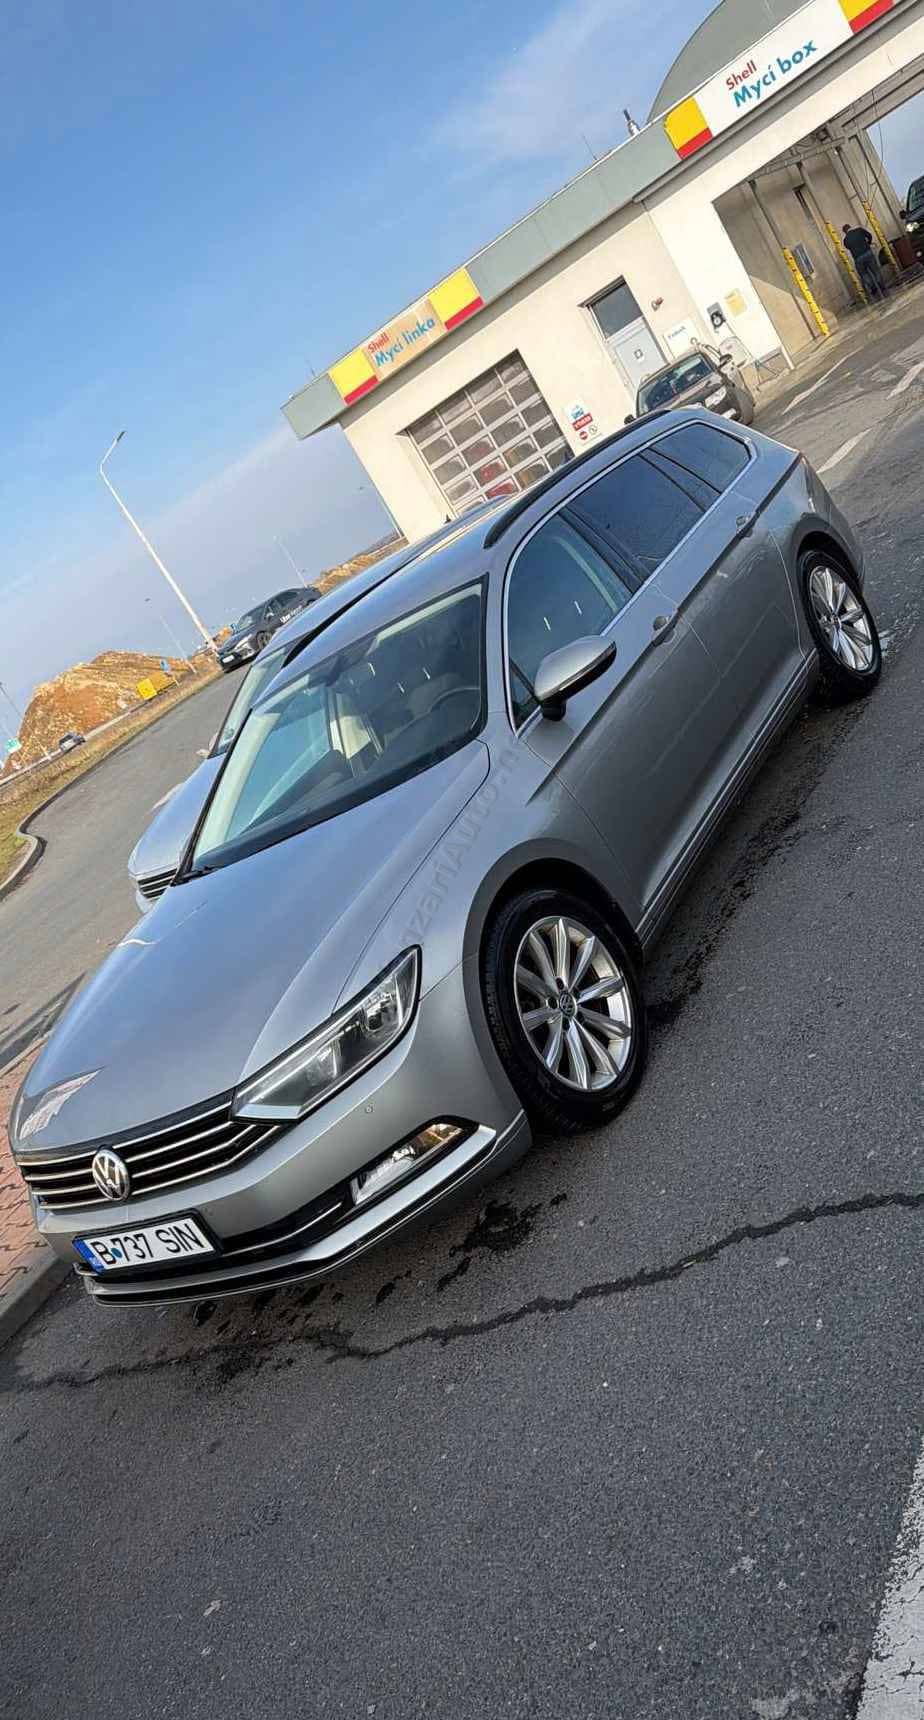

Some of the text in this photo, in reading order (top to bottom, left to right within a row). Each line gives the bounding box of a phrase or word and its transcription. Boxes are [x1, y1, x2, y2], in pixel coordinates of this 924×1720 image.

[725, 60, 758, 91] Shell
[733, 40, 817, 108] Mycí box
[367, 331, 390, 353] Shell
[401, 319, 436, 345] linka
[89, 1241, 117, 1265] B
[109, 1233, 154, 1262] 737
[155, 1223, 205, 1254] SIN
